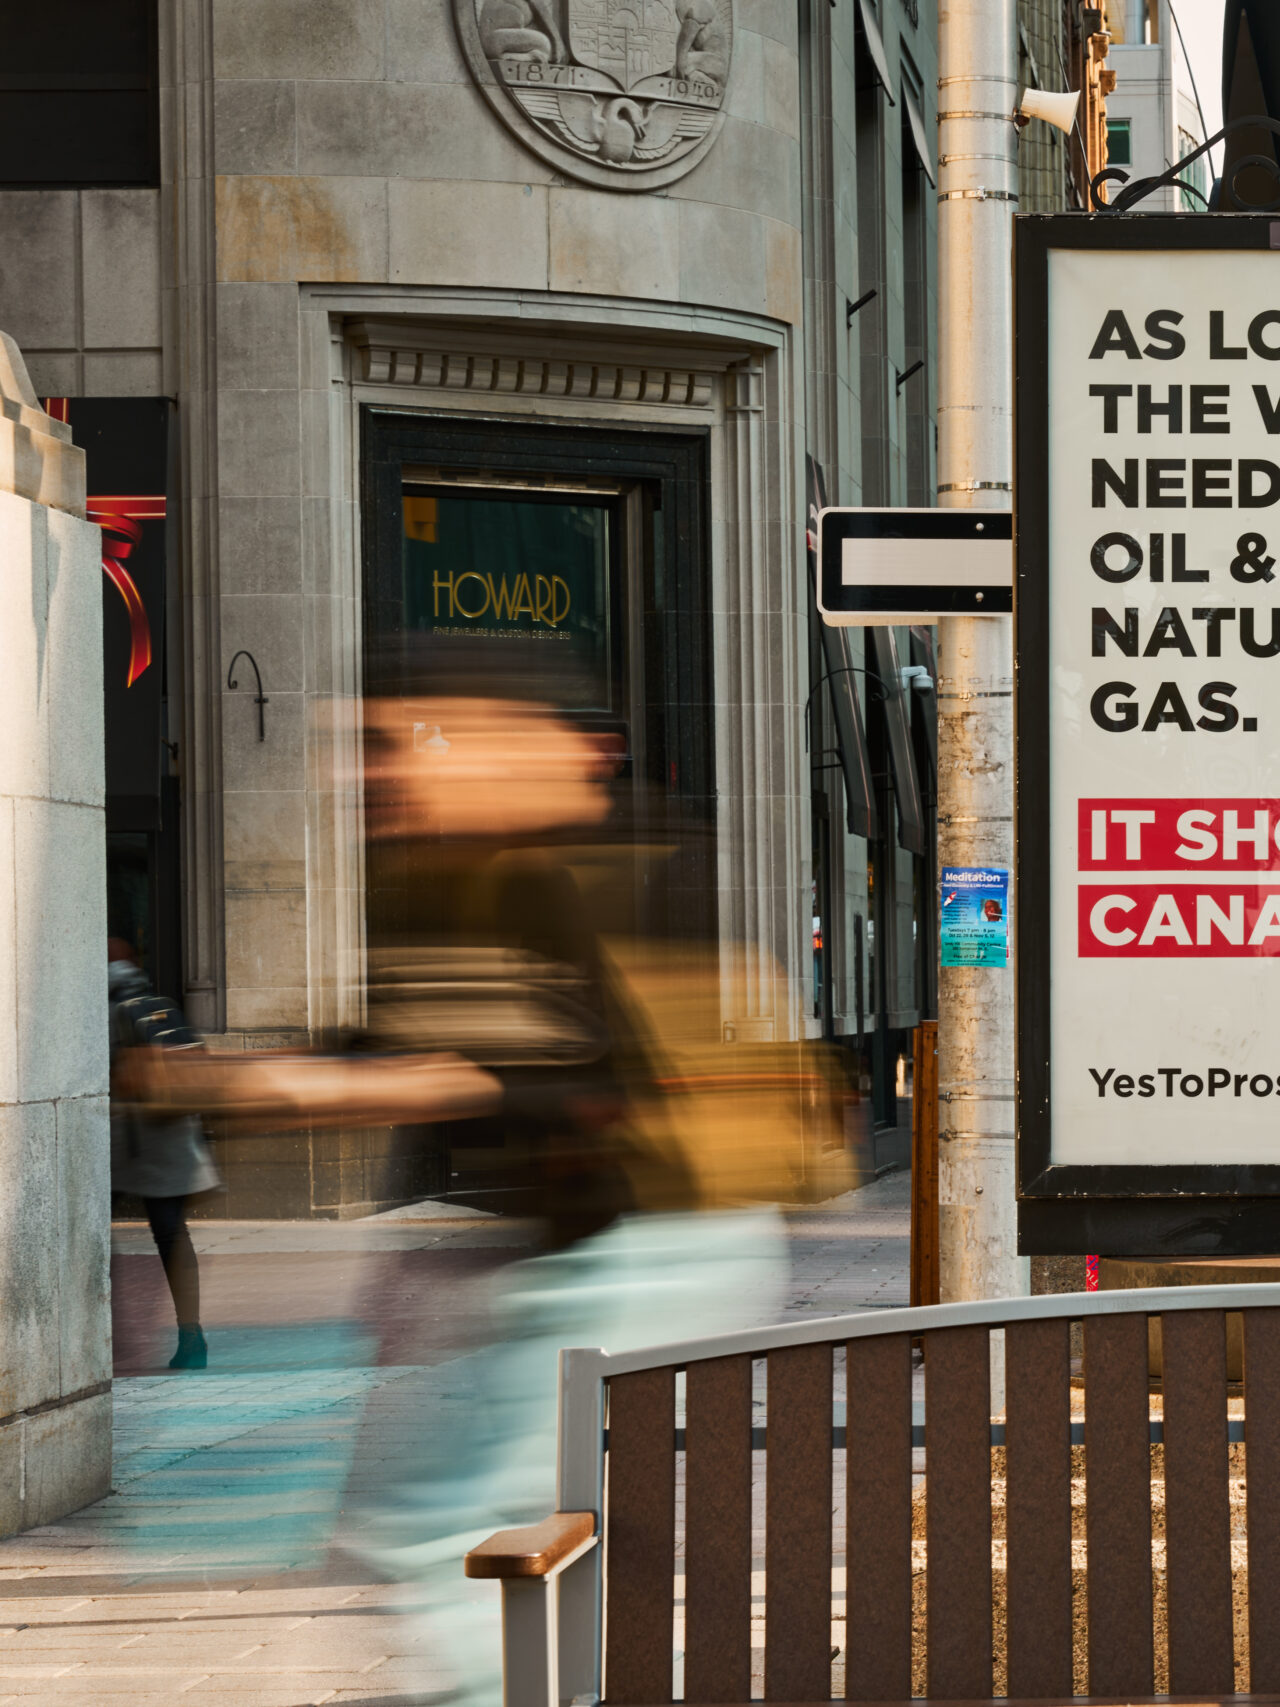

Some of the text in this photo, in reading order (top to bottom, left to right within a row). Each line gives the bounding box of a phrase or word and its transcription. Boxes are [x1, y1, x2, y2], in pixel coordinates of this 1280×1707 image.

[1089, 310, 1185, 361] AS
[1089, 384, 1231, 434] THE
[1090, 532, 1276, 583] OIL &
[433, 570, 571, 628] HOWARD
[433, 626, 571, 640] FINE JEWELLERS & CUSTOM DESIGNERS
[1089, 681, 1257, 733] GAS.
[1091, 810, 1155, 860] IT
[945, 871, 1001, 882] Meditation
